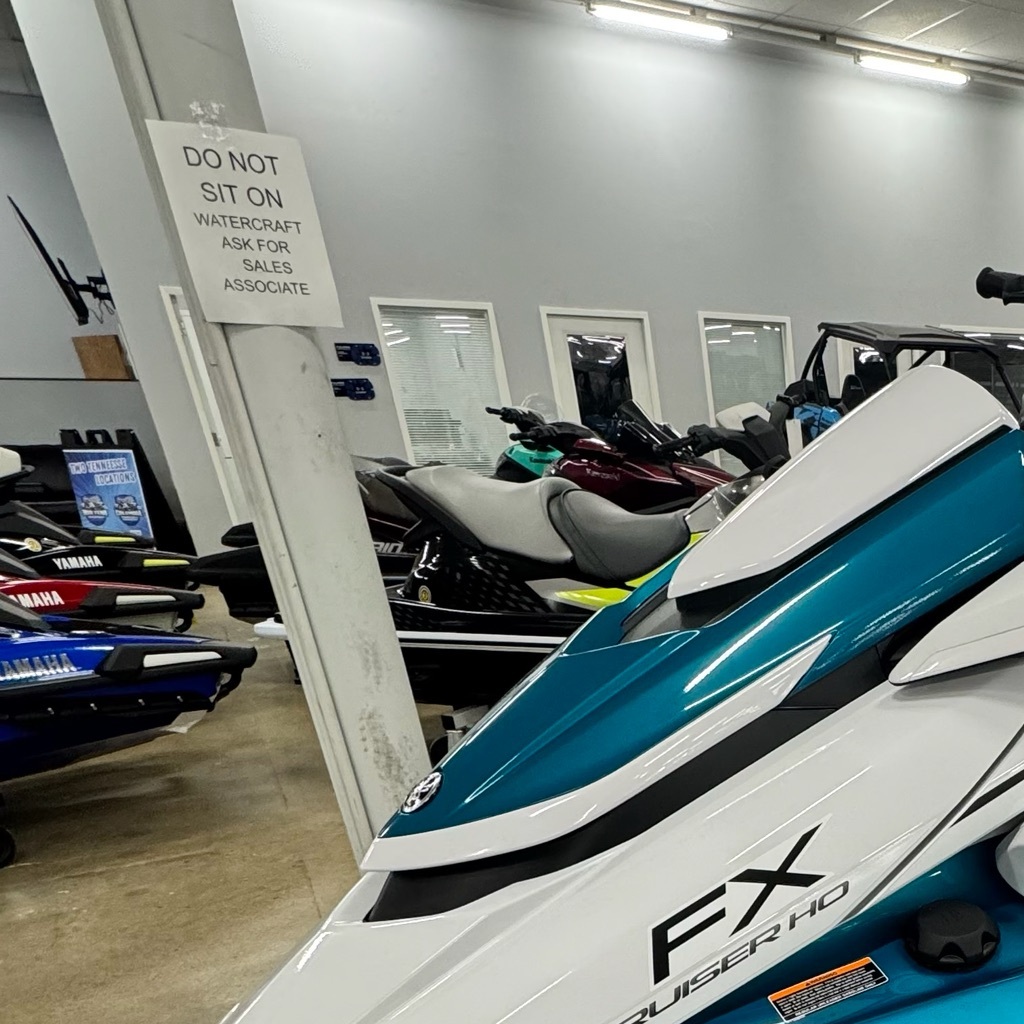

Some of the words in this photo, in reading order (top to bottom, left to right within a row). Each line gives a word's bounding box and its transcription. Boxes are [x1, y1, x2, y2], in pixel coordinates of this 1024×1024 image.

[183, 146, 222, 169] DO
[228, 151, 279, 175] NOT
[200, 182, 238, 204] SIT
[246, 187, 283, 209] ON
[193, 212, 302, 235] WATERCRAFT
[222, 236, 254, 251] ASK
[257, 239, 291, 254] FOR
[242, 259, 293, 274] SALES
[223, 278, 311, 295] ASSOCIATE
[95, 472, 136, 485] LOCATIONS
[52, 555, 103, 570] YAMAHA
[0, 653, 77, 680] AMAHA
[651, 822, 827, 986] FX
[789, 880, 849, 932] HO
